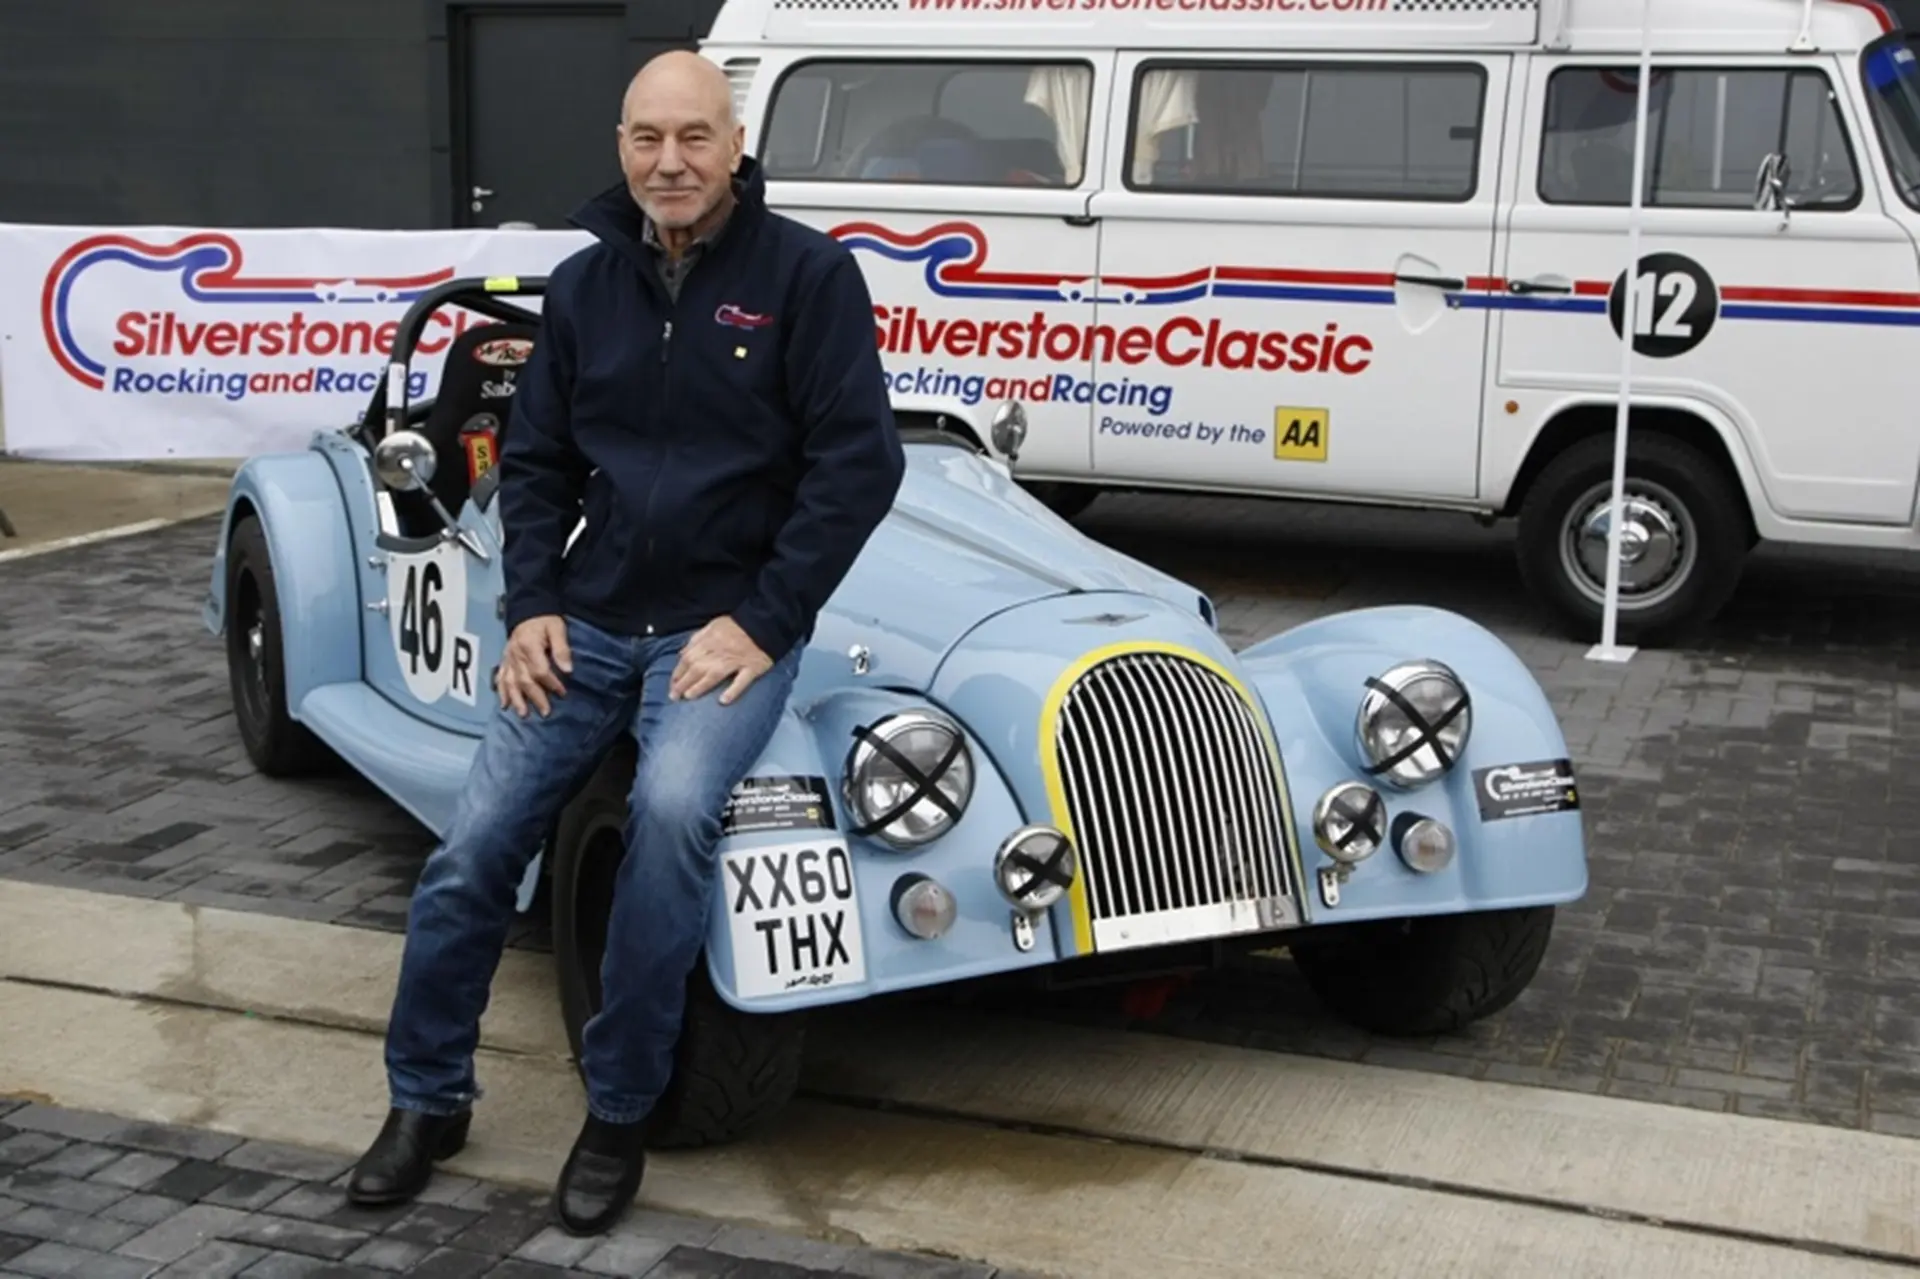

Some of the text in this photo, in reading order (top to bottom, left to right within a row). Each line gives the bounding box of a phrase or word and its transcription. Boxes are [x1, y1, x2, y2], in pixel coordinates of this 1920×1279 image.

[1634, 271, 1698, 338] 12
[113, 367, 428, 401] RockingandRacg
[1099, 416, 1320, 447] Powered by the AA
[400, 560, 443, 675] 46
[453, 636, 472, 696] R
[726, 846, 852, 914] XX60
[754, 910, 850, 975] THX
